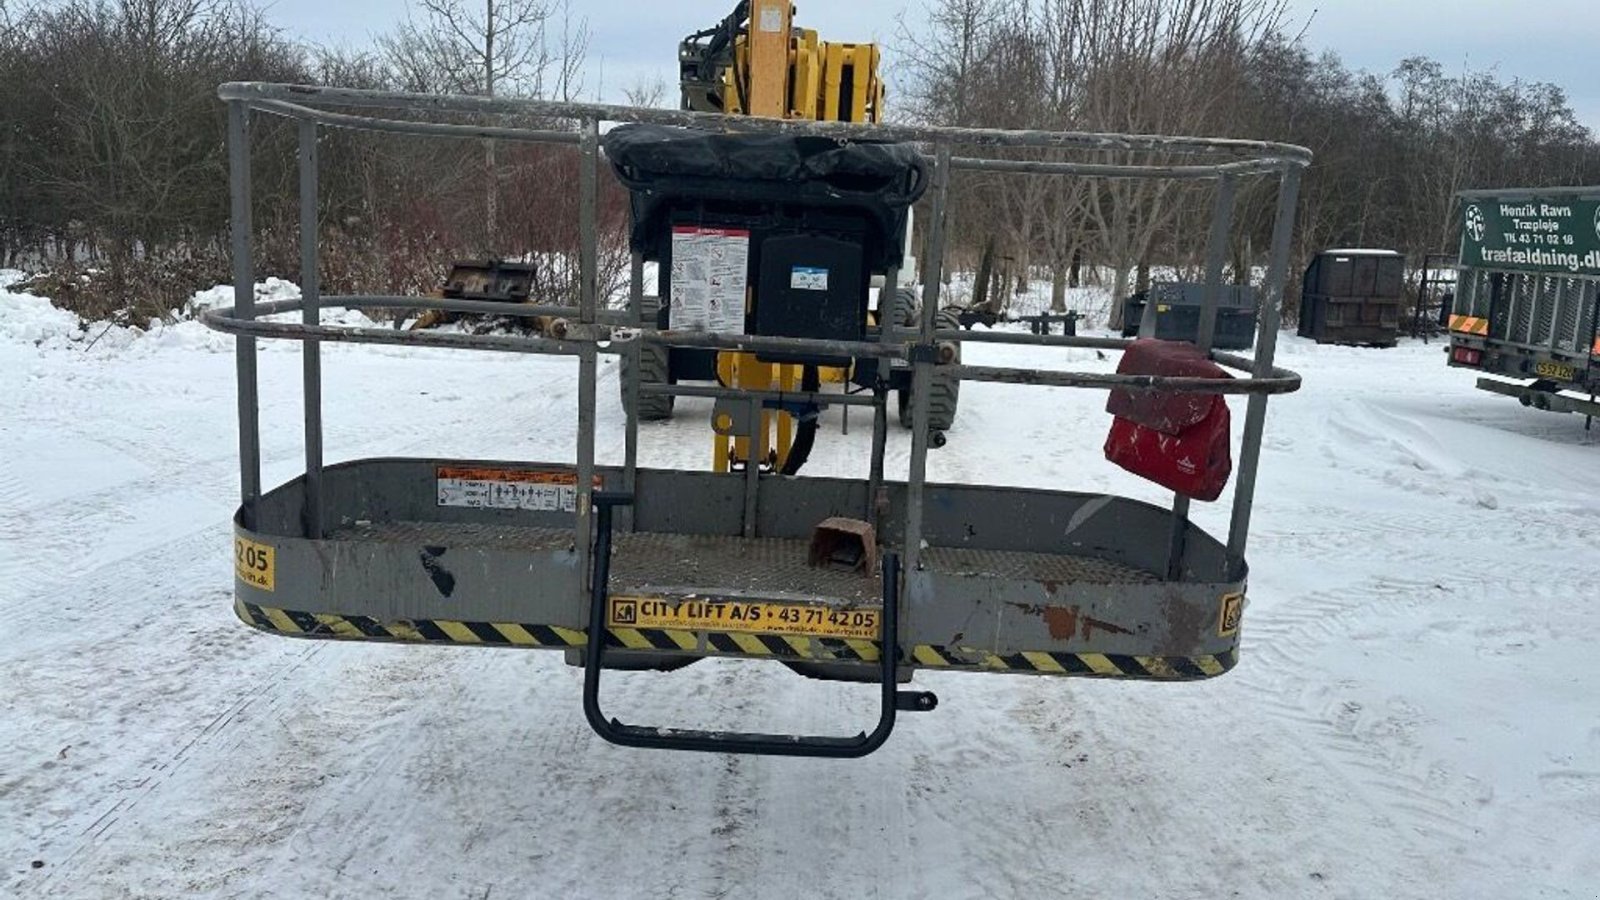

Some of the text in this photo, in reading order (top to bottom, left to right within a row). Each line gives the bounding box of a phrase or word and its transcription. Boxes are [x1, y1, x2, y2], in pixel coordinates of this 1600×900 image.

[1500, 204, 1571, 217] Henrik Ravn
[1518, 233, 1531, 243] 43
[1533, 234, 1543, 244] 71
[1546, 234, 1559, 245] 02
[1562, 234, 1574, 245] 18
[246, 546, 268, 571] 05
[641, 601, 874, 628] CITY LIFT A/S 43 71 42 05
